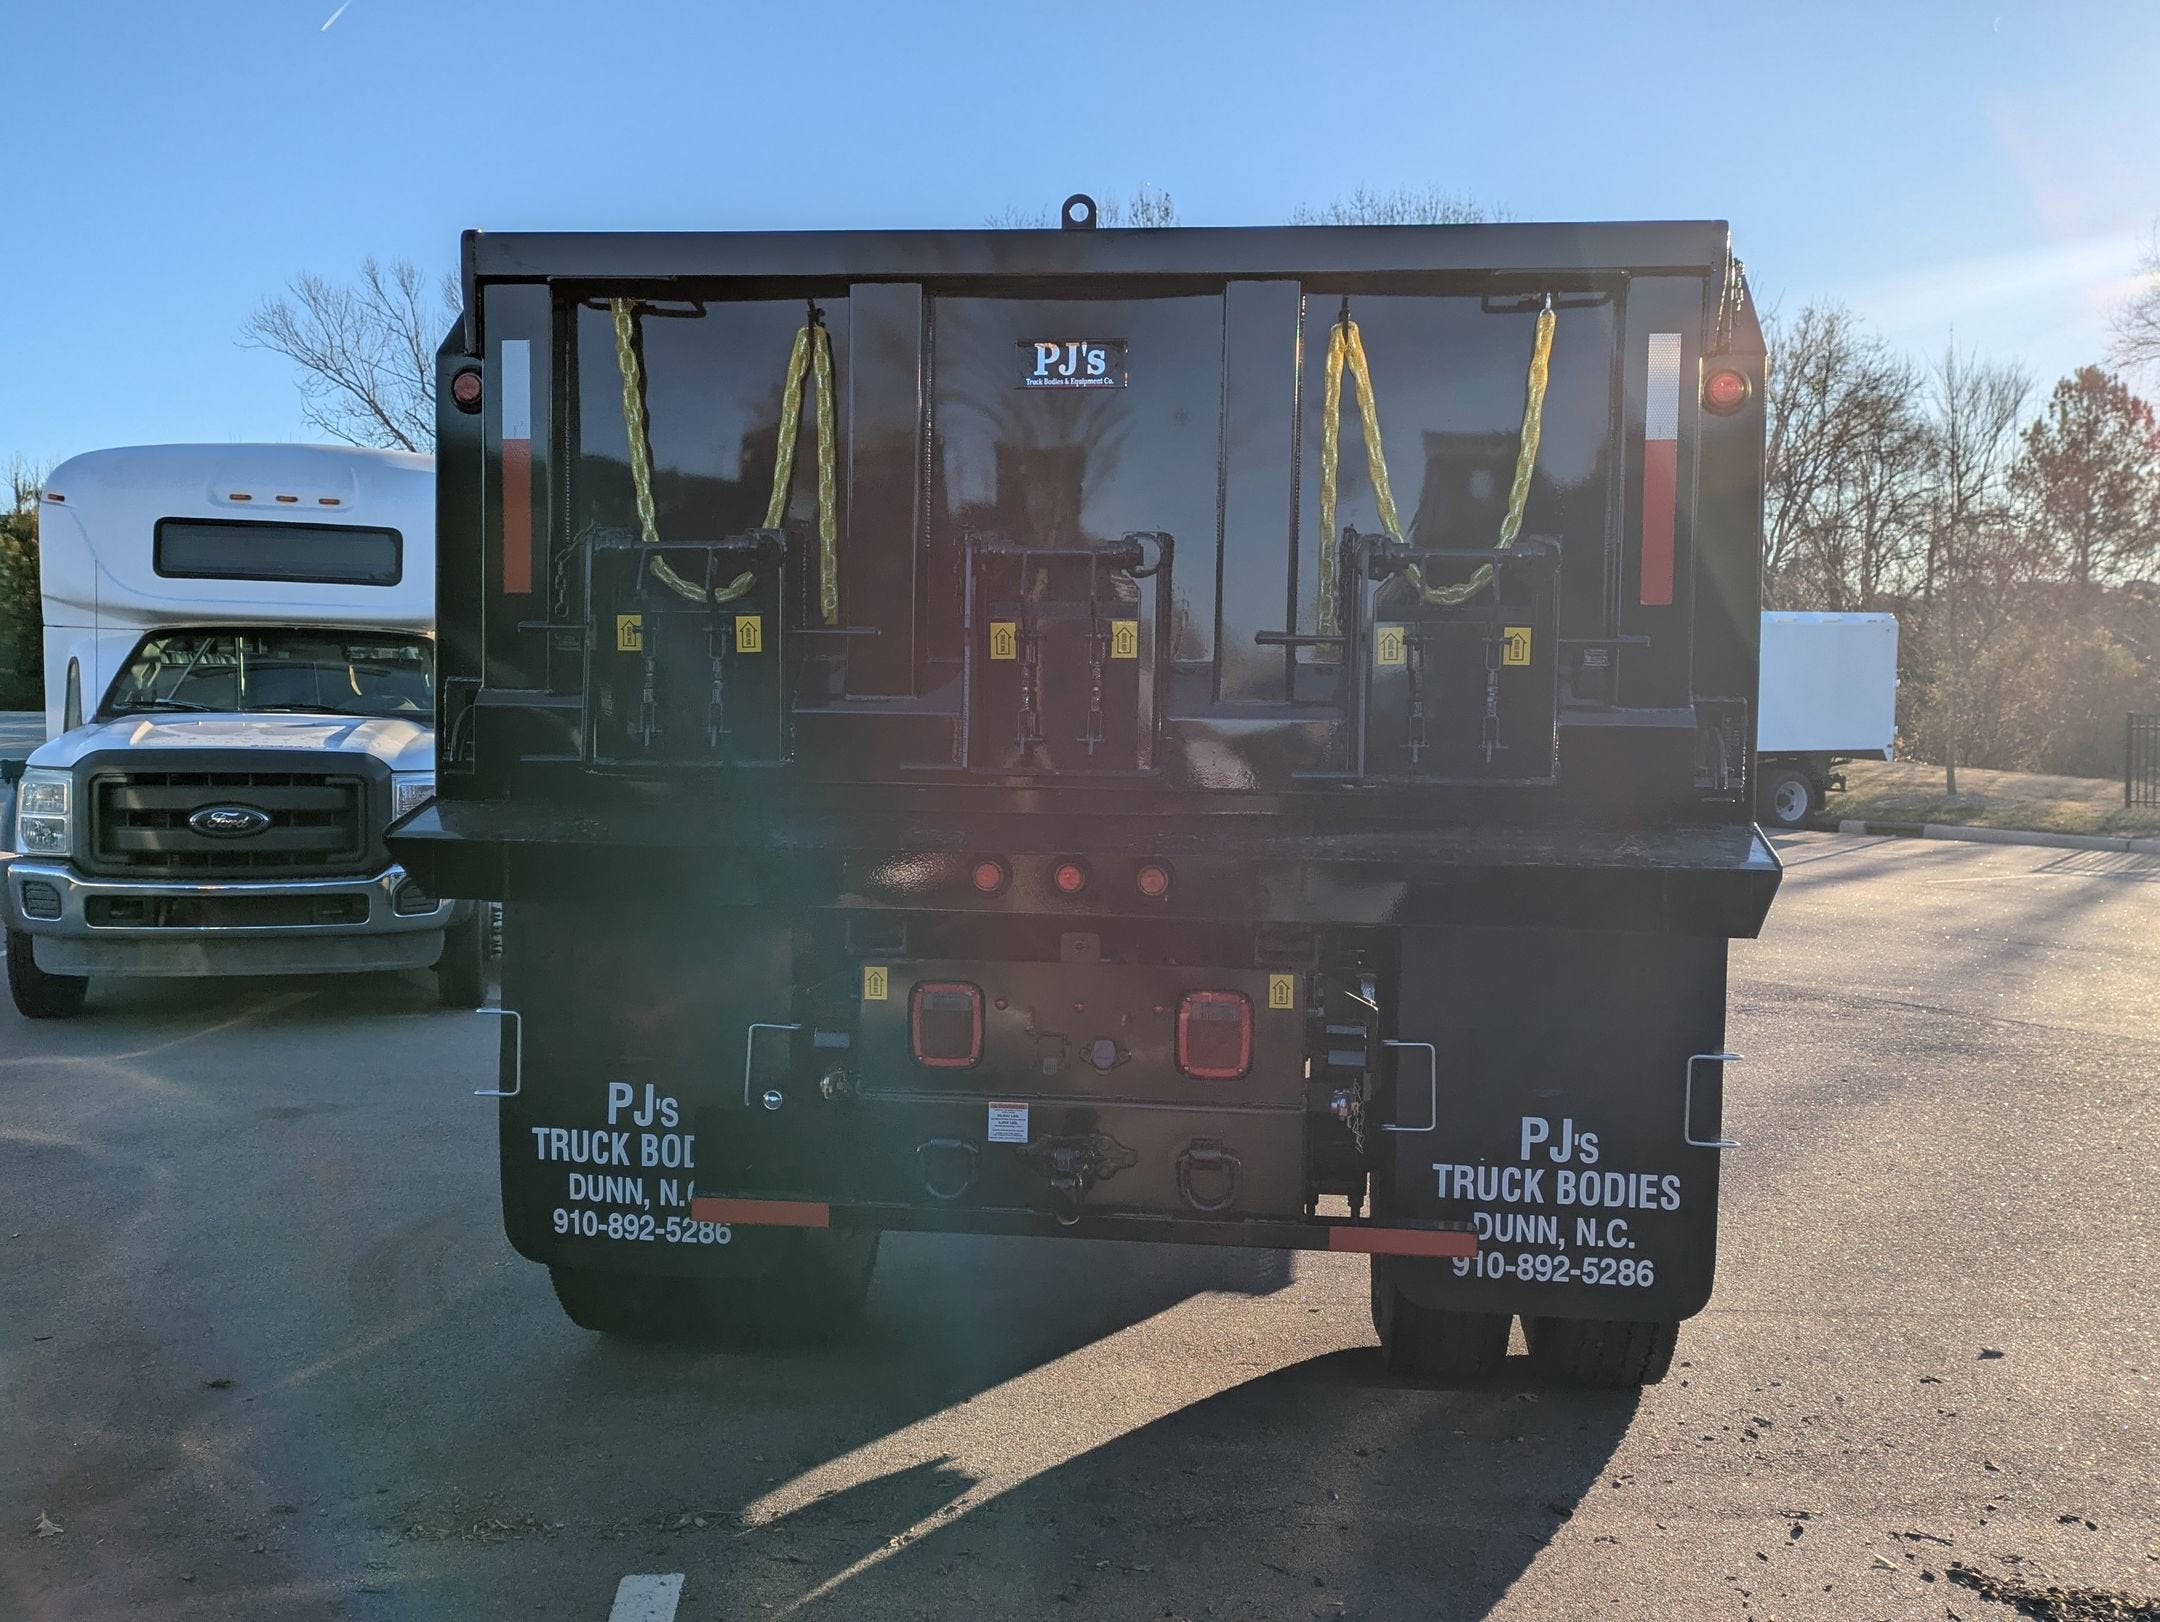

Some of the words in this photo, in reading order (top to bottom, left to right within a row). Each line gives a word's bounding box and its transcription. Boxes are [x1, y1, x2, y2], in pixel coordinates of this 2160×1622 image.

[1034, 341, 1106, 376] PJ's
[1070, 377, 1103, 388] Equipment
[1103, 377, 1114, 385] Co.
[207, 811, 250, 829] Ford
[608, 1082, 679, 1128] PJ's
[531, 1127, 630, 1166] TRUCK
[641, 1133, 695, 1169] BOD
[1520, 1116, 1599, 1164] PJ's
[569, 1172, 650, 1211] DUNN,
[660, 1178, 695, 1207] N.
[1432, 1163, 1545, 1204] TRUCK
[1556, 1169, 1681, 1211] BODIES
[553, 1208, 732, 1245] 910-892-5286
[1473, 1211, 1565, 1251] DUNN,
[1576, 1217, 1636, 1249] N.C.
[1452, 1250, 1655, 1288] 910-892-5286
